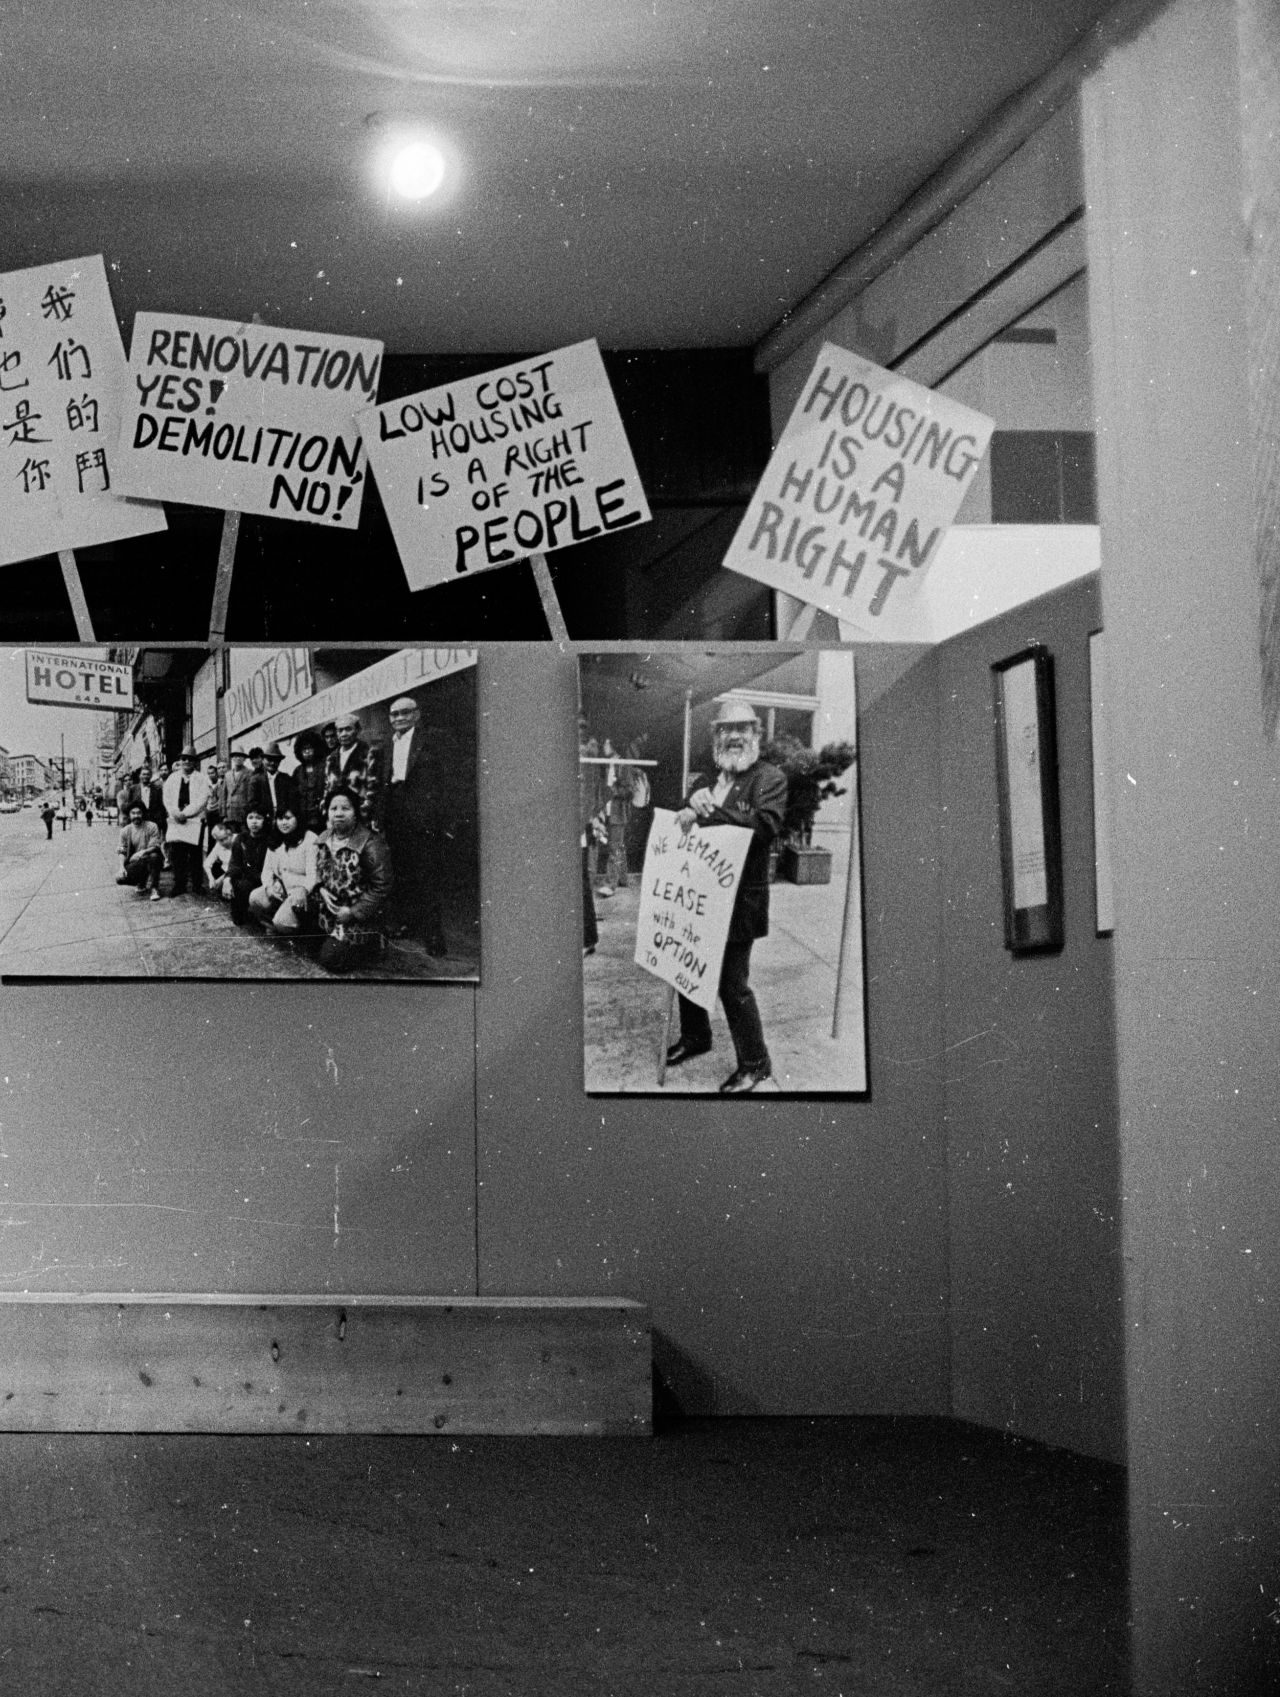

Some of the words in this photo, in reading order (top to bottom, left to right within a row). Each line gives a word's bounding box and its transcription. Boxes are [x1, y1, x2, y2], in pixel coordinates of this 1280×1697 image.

[136, 373, 224, 416] YES!
[147, 329, 380, 402] RENOVATION,
[379, 391, 455, 442] LOW
[476, 360, 554, 411] COST
[430, 392, 563, 460] HOUSING
[803, 365, 979, 482] HOUSING
[133, 412, 363, 484] DEMOLITION,
[417, 471, 450, 505] IS
[467, 457, 487, 484] A
[504, 420, 593, 477] RIGHT
[817, 428, 864, 481] IS
[870, 461, 906, 503] A
[269, 474, 353, 521] NO!
[471, 481, 510, 511] OF
[527, 458, 585, 498] THE
[778, 459, 941, 568] HUMAN
[455, 478, 642, 574] PEOPLE
[747, 500, 911, 617] RIGHT
[32, 655, 129, 676] INTERNATIONAL
[34, 666, 128, 696] HOTEL
[651, 835, 669, 856] WE
[677, 832, 735, 889] DEMAND
[680, 860, 690, 878] A
[652, 878, 708, 916] LEASE
[644, 951, 658, 968] TO
[674, 971, 700, 994] BUY
[653, 931, 708, 979] OPTION
